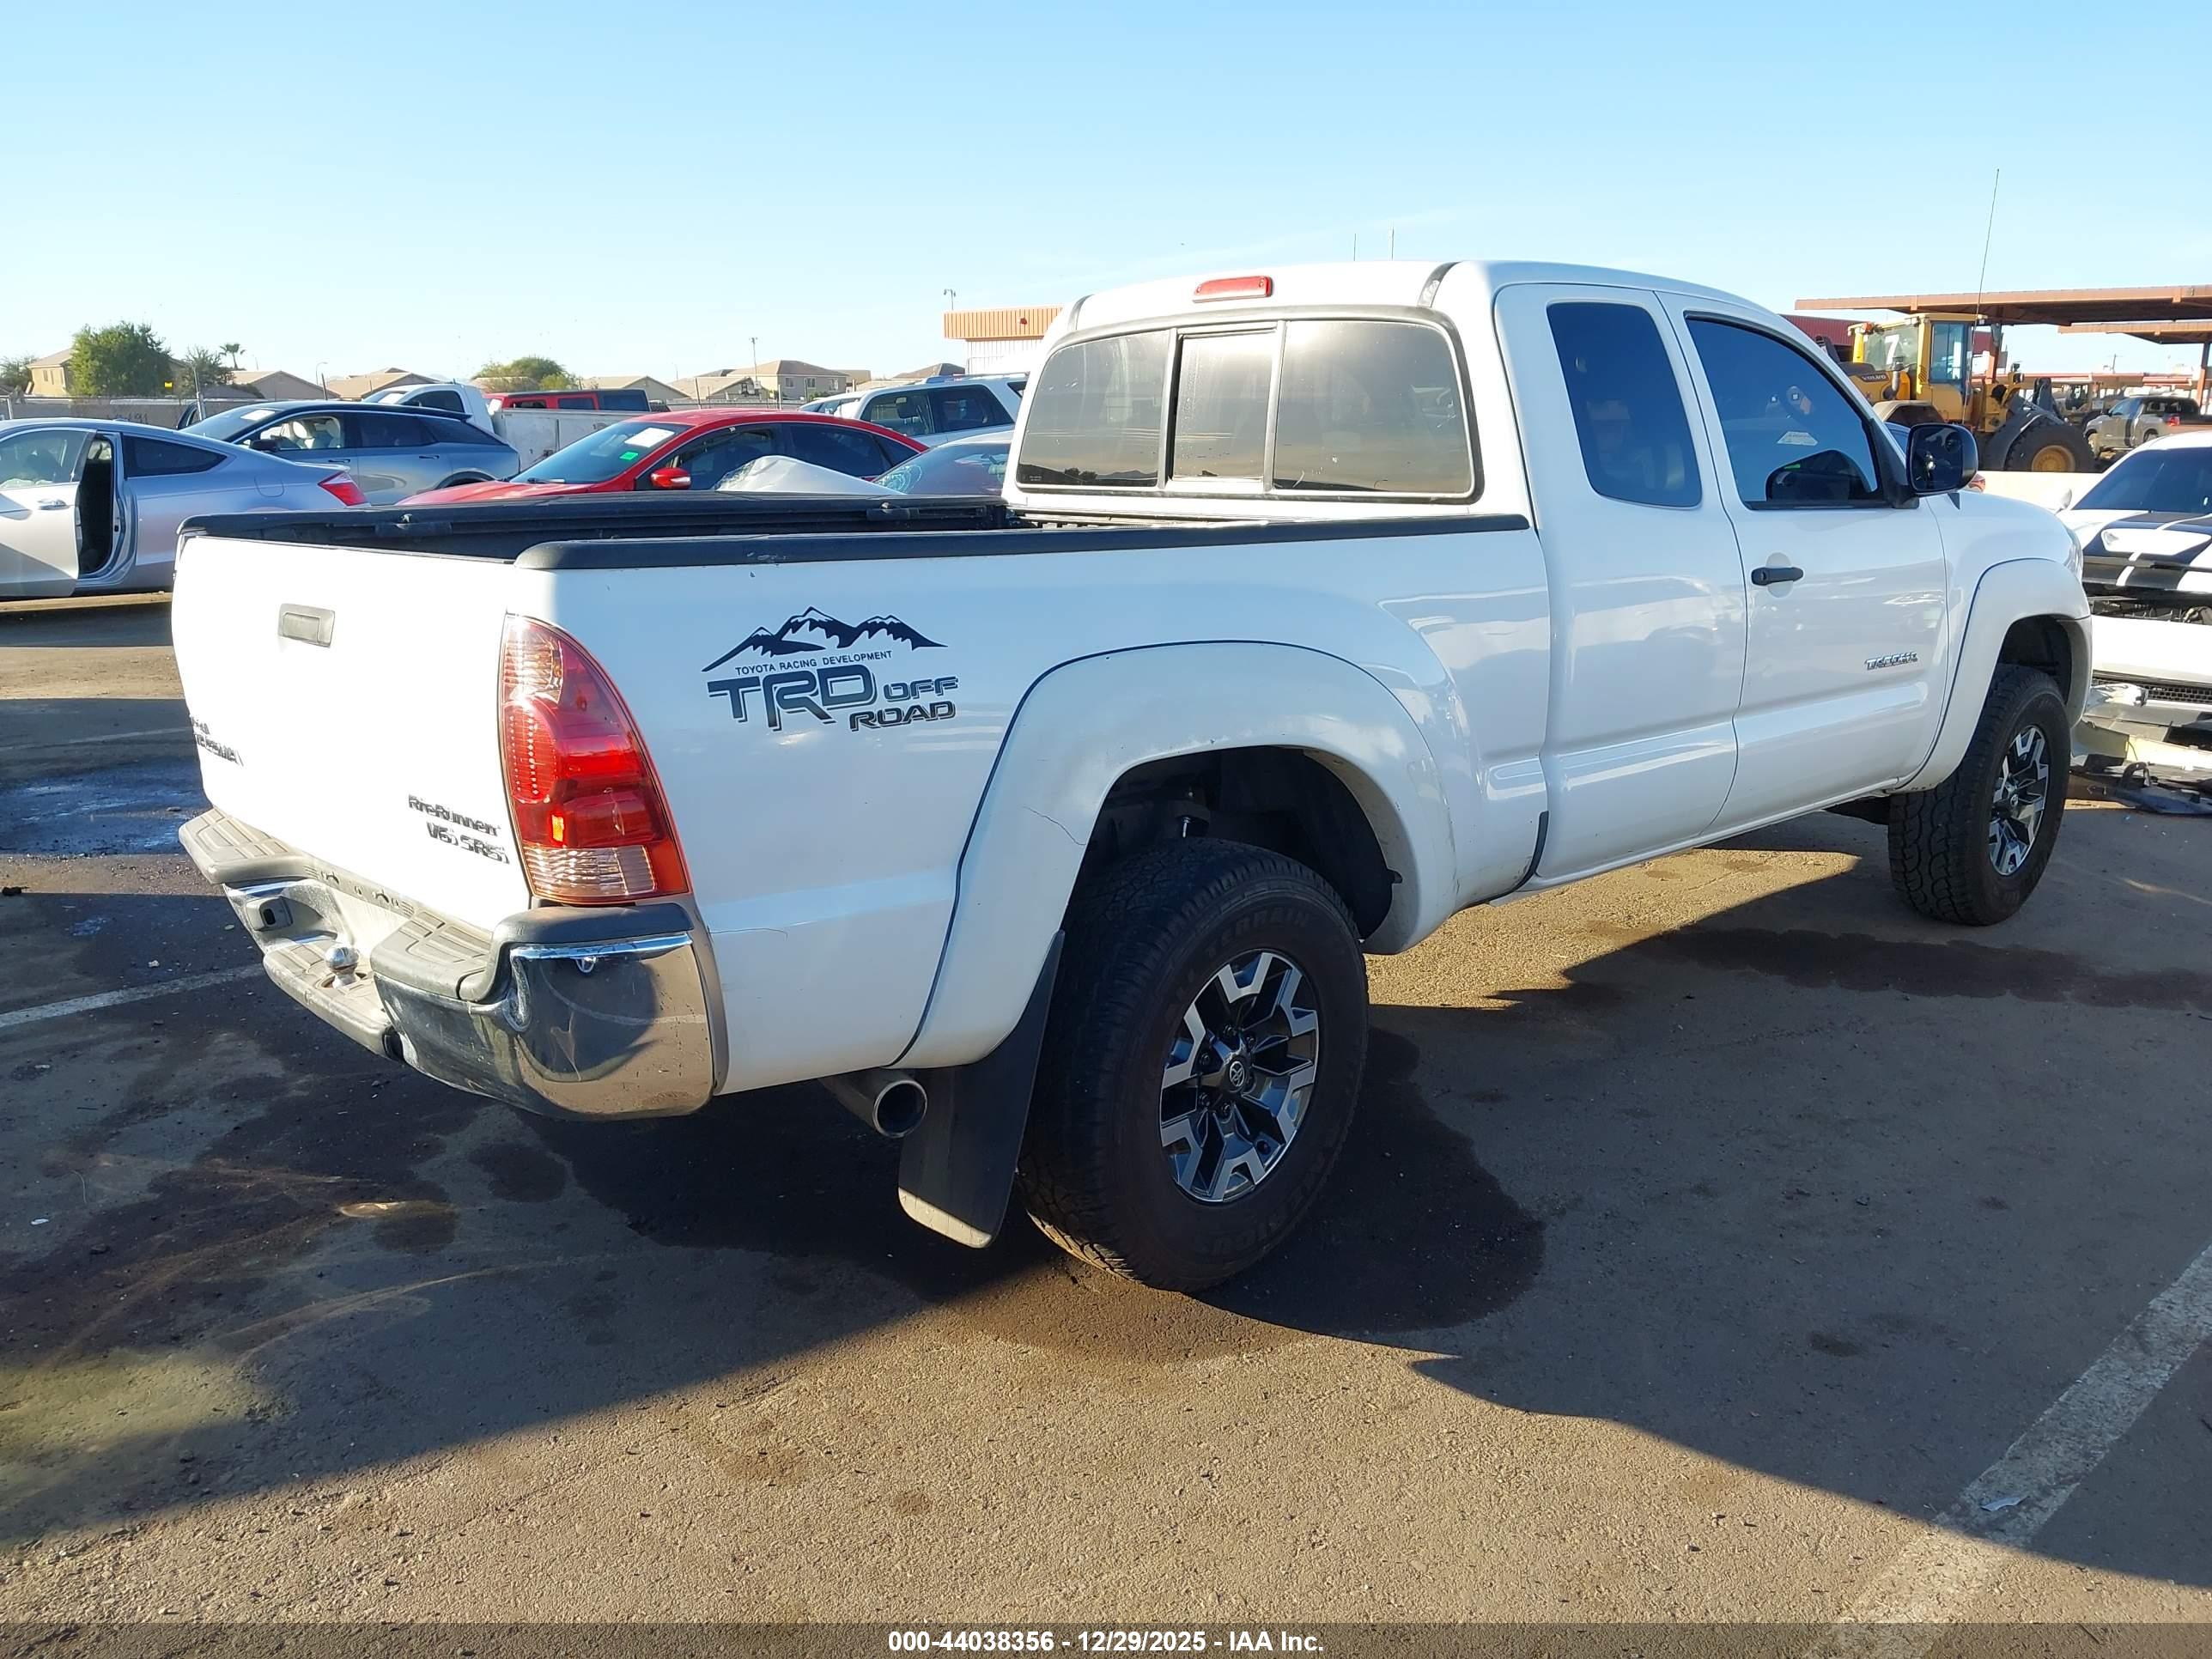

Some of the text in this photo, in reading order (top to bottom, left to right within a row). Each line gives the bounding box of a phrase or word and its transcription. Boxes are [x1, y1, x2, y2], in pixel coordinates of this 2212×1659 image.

[1884, 334, 1900, 365] 7
[735, 650, 893, 676] TOYOTA RACING DEVELOPMENT
[707, 664, 878, 732] TRD
[883, 676, 959, 702] OFF
[849, 701, 957, 732] ROAD
[426, 820, 509, 864] V6 SR5
